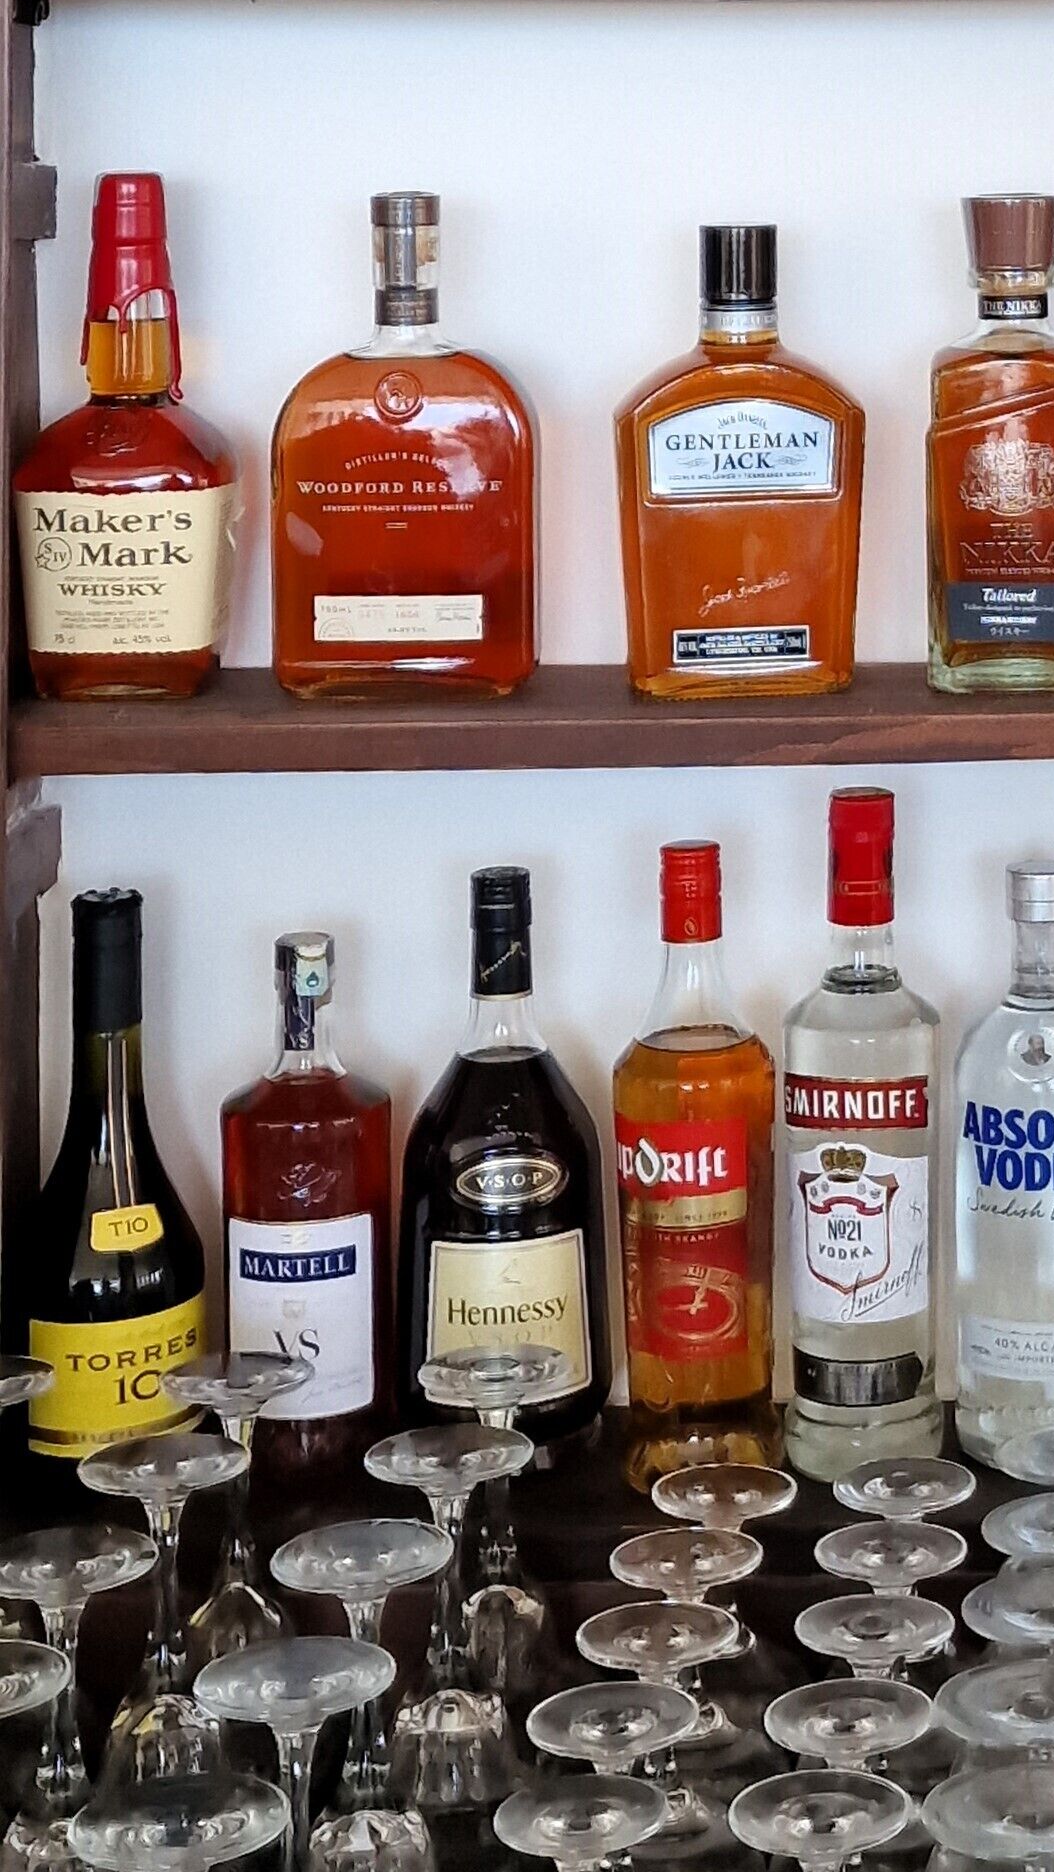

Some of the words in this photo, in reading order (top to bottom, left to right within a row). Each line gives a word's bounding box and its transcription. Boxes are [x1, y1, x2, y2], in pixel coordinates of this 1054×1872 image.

[665, 430, 820, 452] GENTLEMAN
[345, 451, 408, 470] DISTILLER'S
[712, 451, 775, 475] JACK
[297, 480, 404, 495] WOODFORD
[413, 480, 502, 495] RESVE
[32, 508, 192, 534] Maker's
[76, 541, 193, 568] Mark
[57, 583, 166, 597] WHISKY
[982, 588, 1037, 603] Tailored
[785, 1085, 922, 1120] SMIRNOFF
[967, 1186, 1045, 1220] Swedish
[108, 1216, 149, 1237] T10
[818, 1242, 874, 1260] VODKA
[244, 1251, 351, 1278] MARTELL
[448, 1294, 568, 1327] Hennessy
[65, 1327, 197, 1372] TORRES
[273, 1328, 320, 1360] VS
[995, 1337, 1020, 1350] 40%
